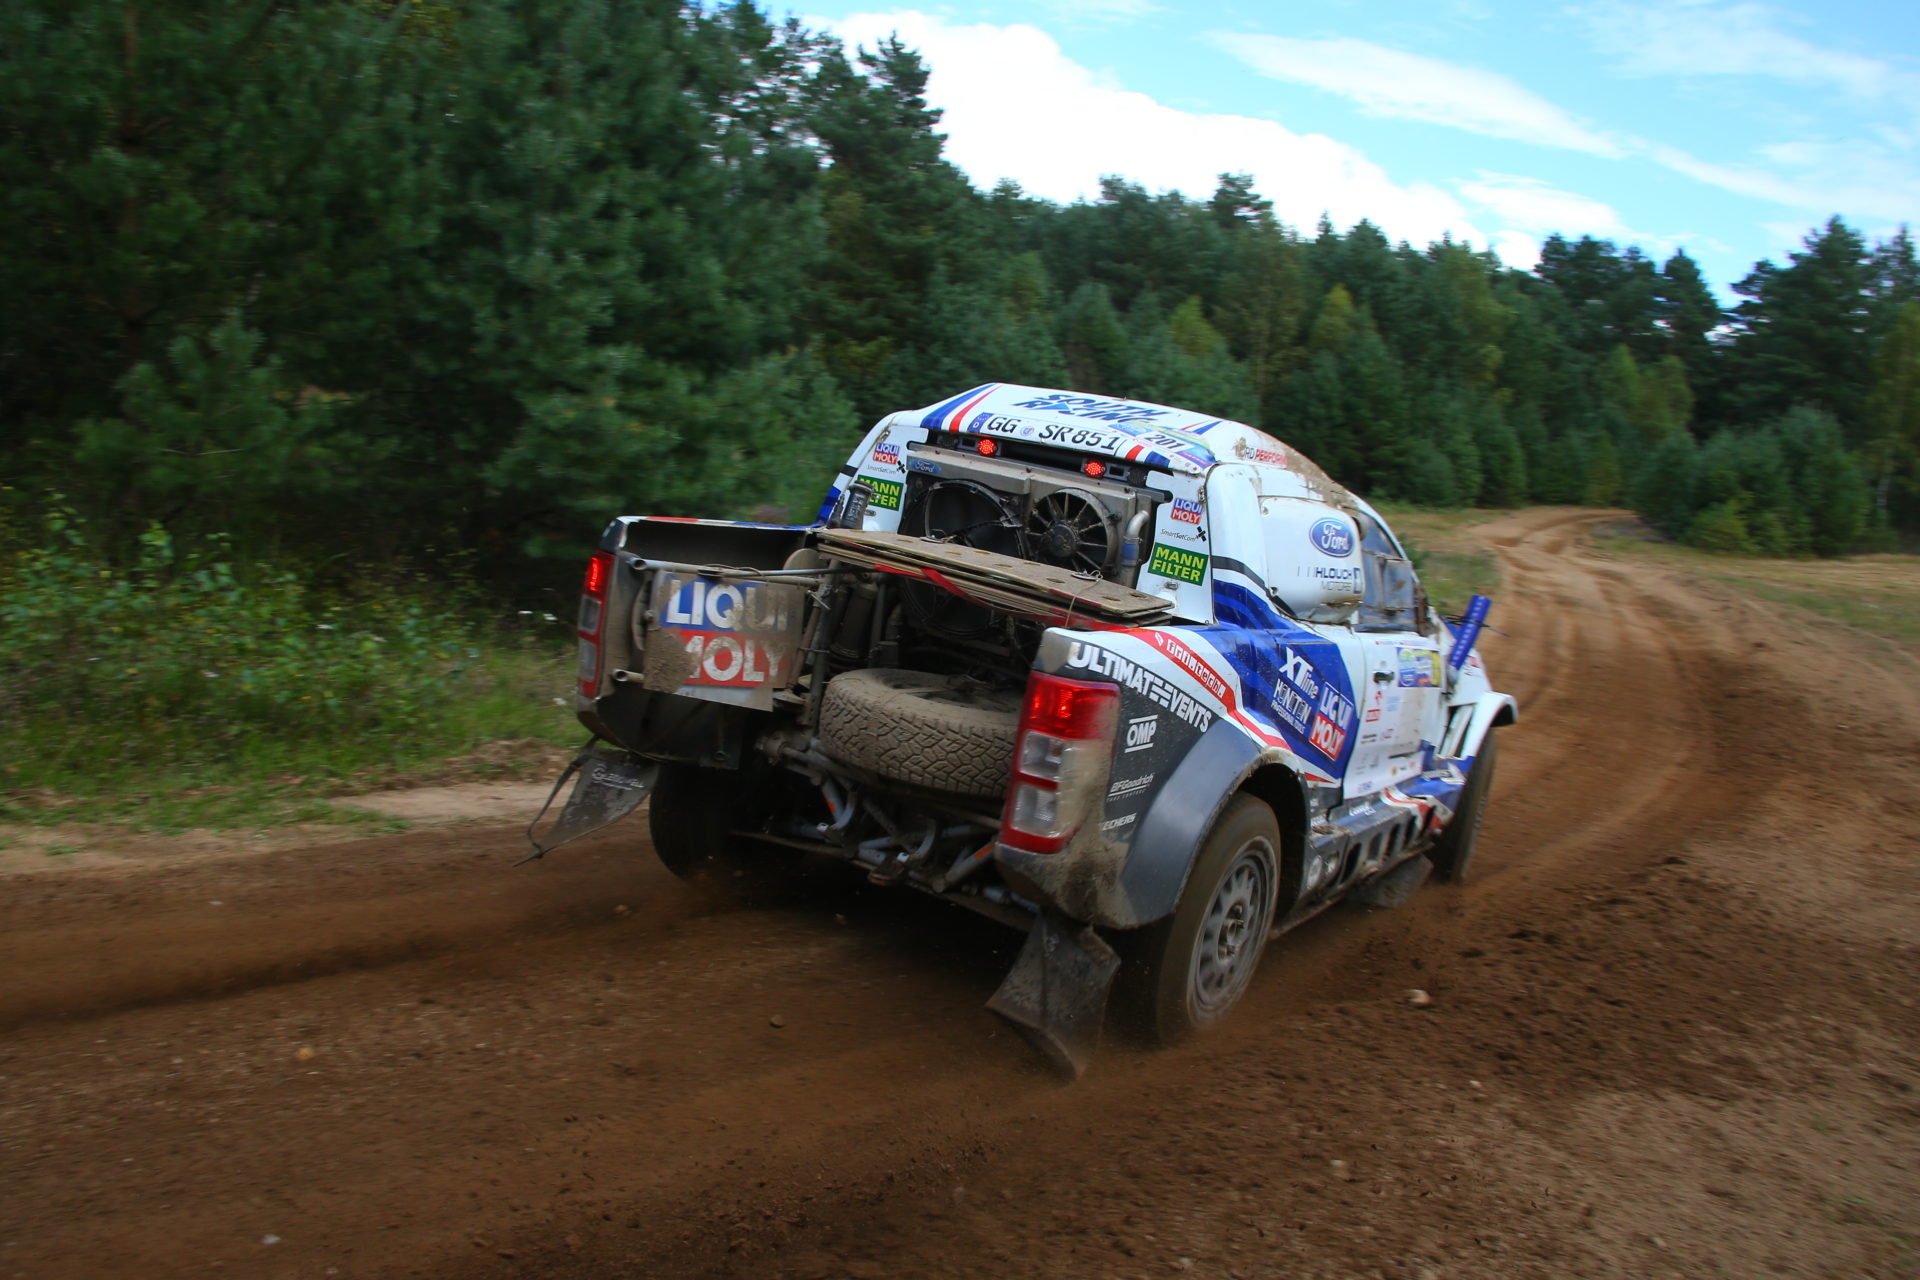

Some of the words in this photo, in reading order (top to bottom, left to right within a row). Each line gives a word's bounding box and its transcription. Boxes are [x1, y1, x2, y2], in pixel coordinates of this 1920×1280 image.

[1034, 394, 1174, 417] SOUTH
[987, 416, 1021, 433] GG
[1039, 424, 1074, 442] SR
[1072, 430, 1120, 450] 851
[1144, 434, 1186, 449] 201
[873, 452, 898, 465] MOLY
[876, 443, 900, 455] LIQUI
[915, 460, 935, 473] Ford
[860, 477, 900, 497] ANN
[1172, 509, 1201, 524] MOLY
[1175, 498, 1203, 513] LIQUI
[1161, 529, 1196, 542] SmartSatCom
[1321, 522, 1350, 550] Ford
[1155, 546, 1205, 570] MANN
[1152, 559, 1201, 581] FILTER
[667, 579, 789, 632] LIQUI
[1279, 646, 1319, 699] XTline
[1126, 720, 1157, 747] OMP
[1311, 714, 1345, 756] MOLY
